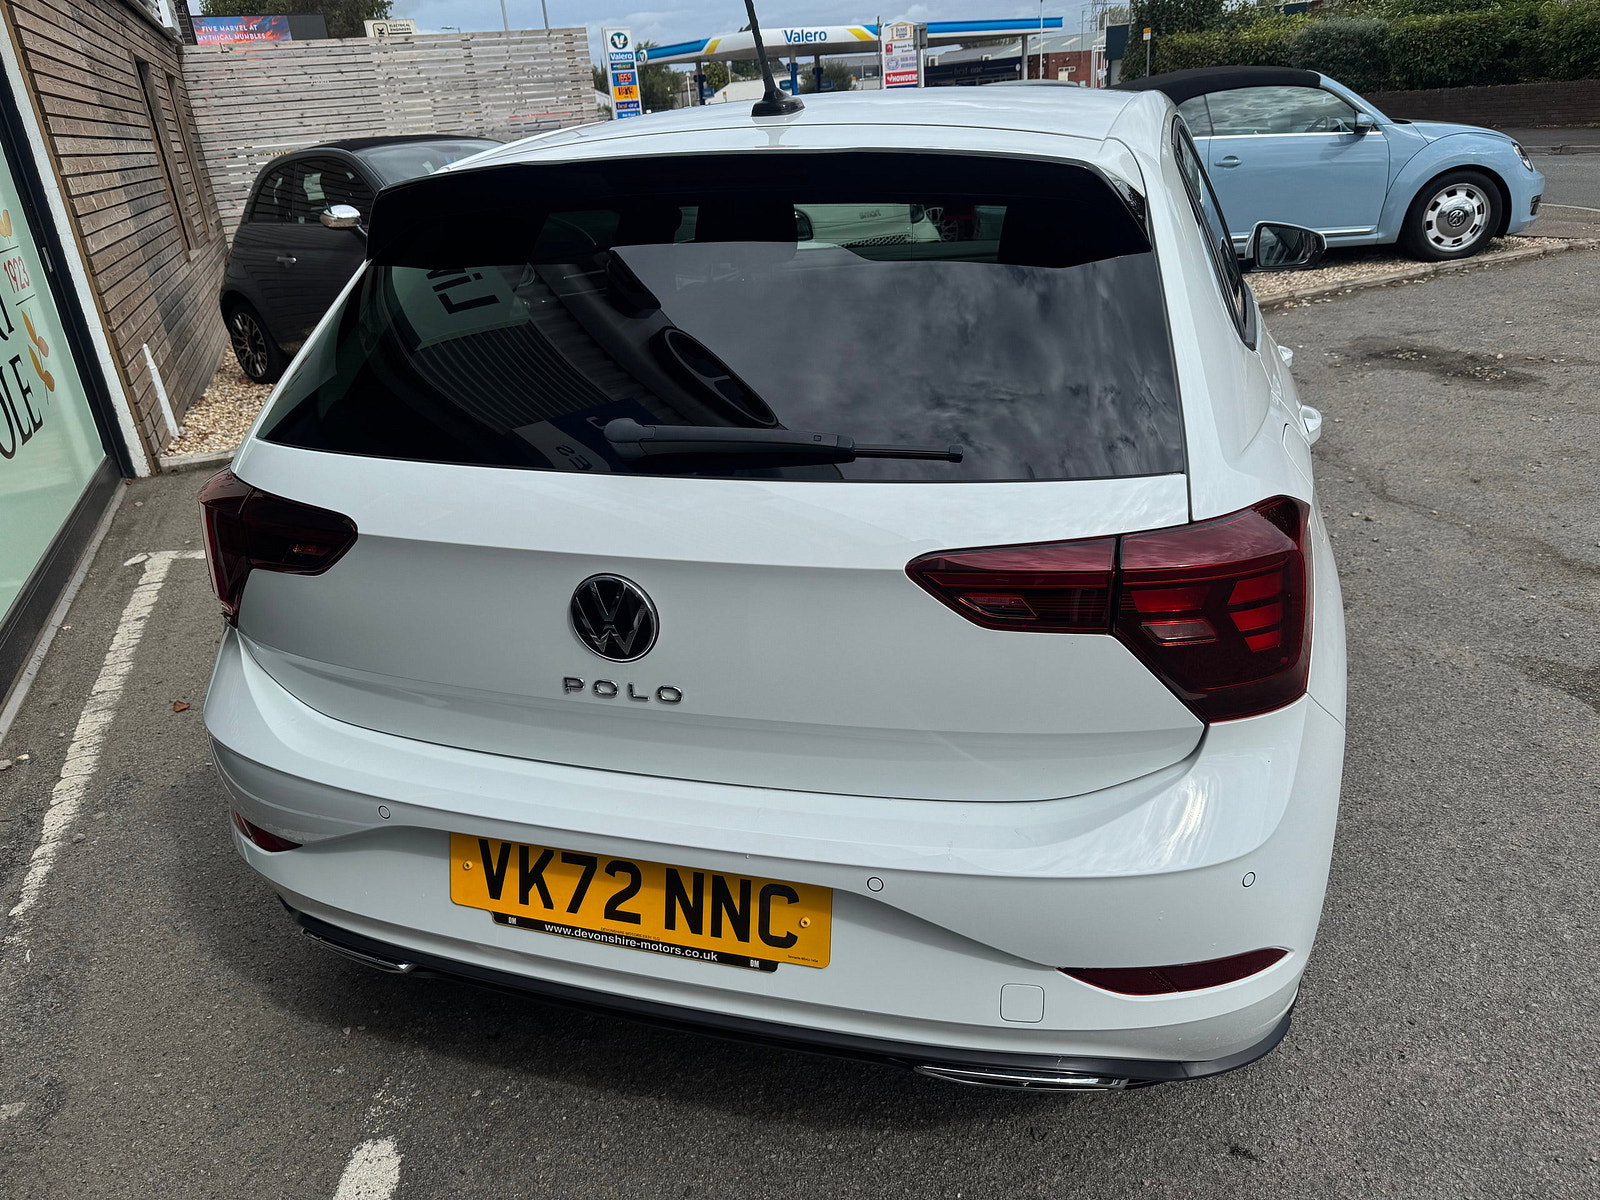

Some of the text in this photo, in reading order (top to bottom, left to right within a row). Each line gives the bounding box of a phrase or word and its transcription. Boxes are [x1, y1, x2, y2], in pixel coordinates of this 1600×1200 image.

[784, 30, 828, 43] Valero
[611, 52, 633, 60] Valero
[4, 256, 30, 293] 1923
[563, 676, 684, 705] POLO
[478, 838, 800, 950] VK72 NNC
[508, 916, 517, 925] DM
[544, 922, 719, 962] www.devonshire-motors.co.uk
[750, 958, 760, 969] DM
